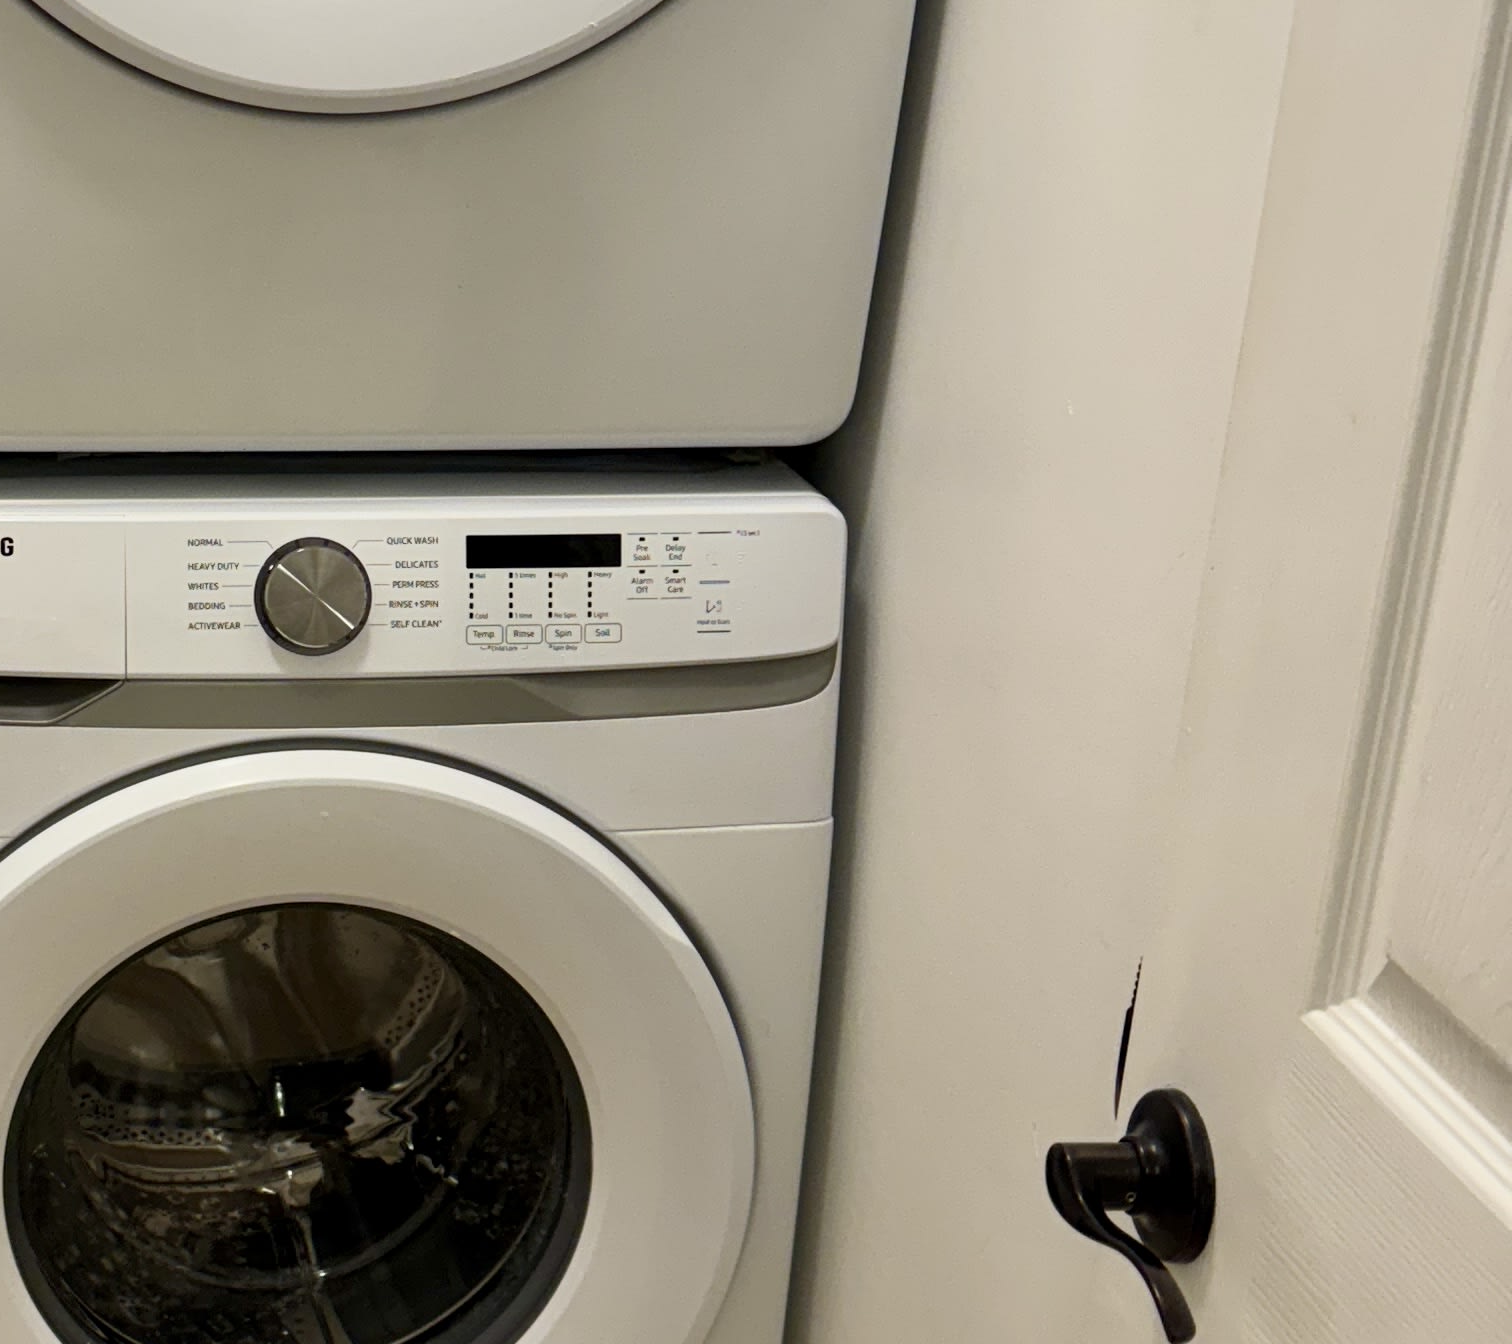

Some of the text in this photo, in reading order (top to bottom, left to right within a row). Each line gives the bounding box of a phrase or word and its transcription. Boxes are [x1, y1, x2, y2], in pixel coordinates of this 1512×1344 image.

[187, 539, 224, 547] NORMAL
[386, 536, 439, 546] QUICK WASH
[665, 544, 687, 553] Delay
[188, 562, 240, 571] HEAVY DUTY
[395, 560, 439, 569] DELICATES
[392, 580, 440, 589] PERM PRESS
[630, 577, 655, 585] Alarm
[664, 576, 687, 585] Smart
[188, 582, 220, 591] WHITES
[188, 602, 226, 611] BEDDING
[388, 600, 413, 608] RINSE
[419, 600, 439, 608] SPIN
[188, 622, 241, 630] ACTIVEWEAR
[390, 619, 410, 628] SELF
[513, 630, 535, 638] Rinse
[555, 629, 573, 639] Spin
